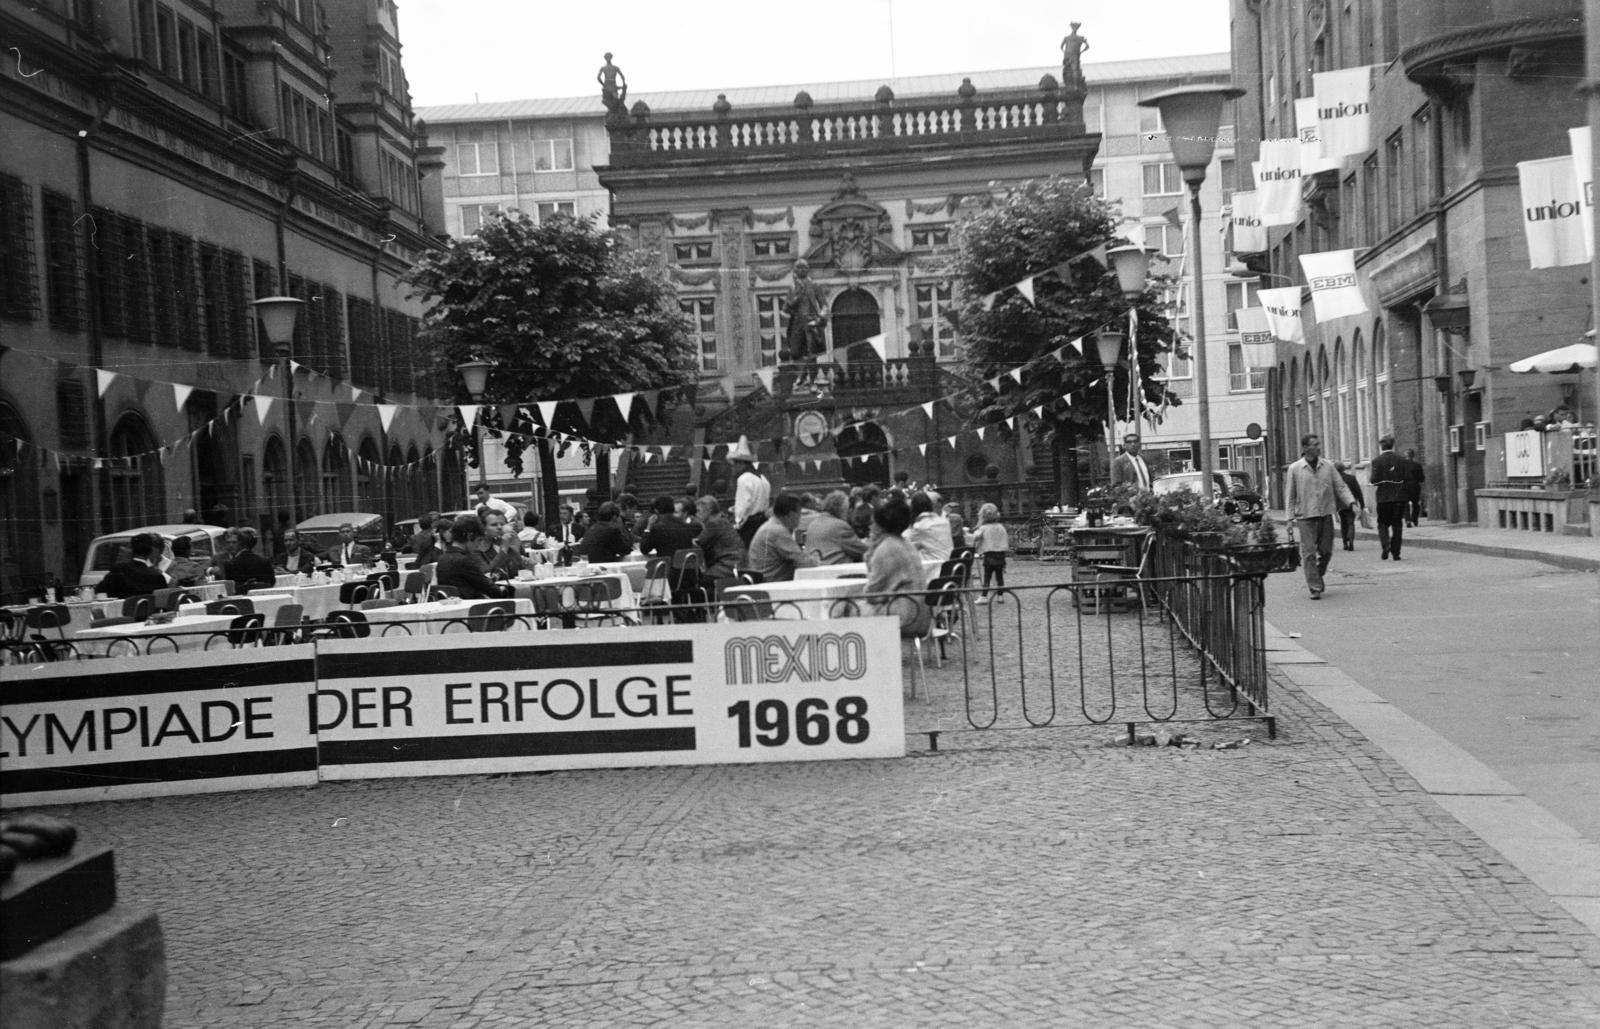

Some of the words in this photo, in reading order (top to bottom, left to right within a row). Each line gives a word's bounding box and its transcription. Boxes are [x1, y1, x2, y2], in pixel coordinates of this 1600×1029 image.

[1318, 102, 1369, 120] union
[1260, 168, 1301, 181] union
[1313, 275, 1354, 289] EBM
[724, 632, 868, 685] MEXICO
[308, 686, 413, 735] DER
[445, 675, 694, 725] ERFOLGE
[727, 696, 870, 748] 1968
